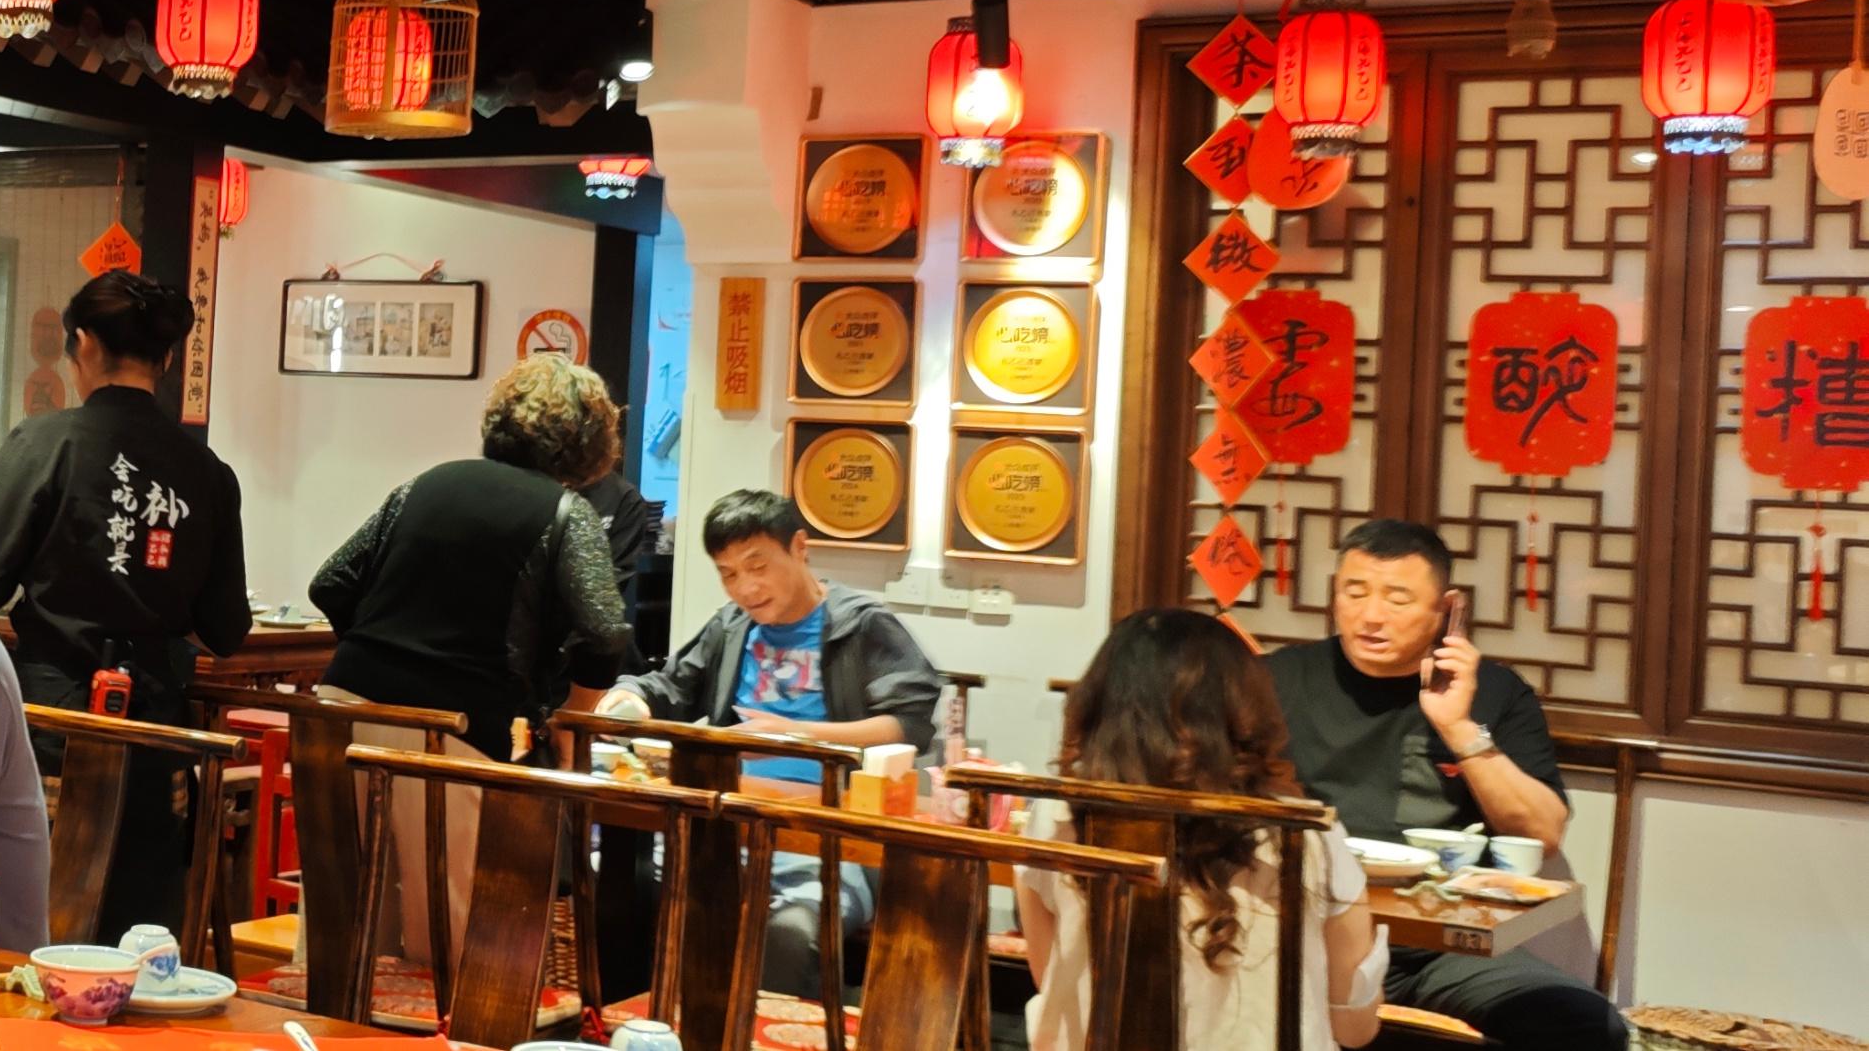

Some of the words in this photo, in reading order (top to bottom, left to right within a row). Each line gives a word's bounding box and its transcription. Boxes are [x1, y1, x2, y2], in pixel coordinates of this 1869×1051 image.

[724, 292, 752, 396] 禁止吸烟
[106, 451, 140, 576] 会吃就是
